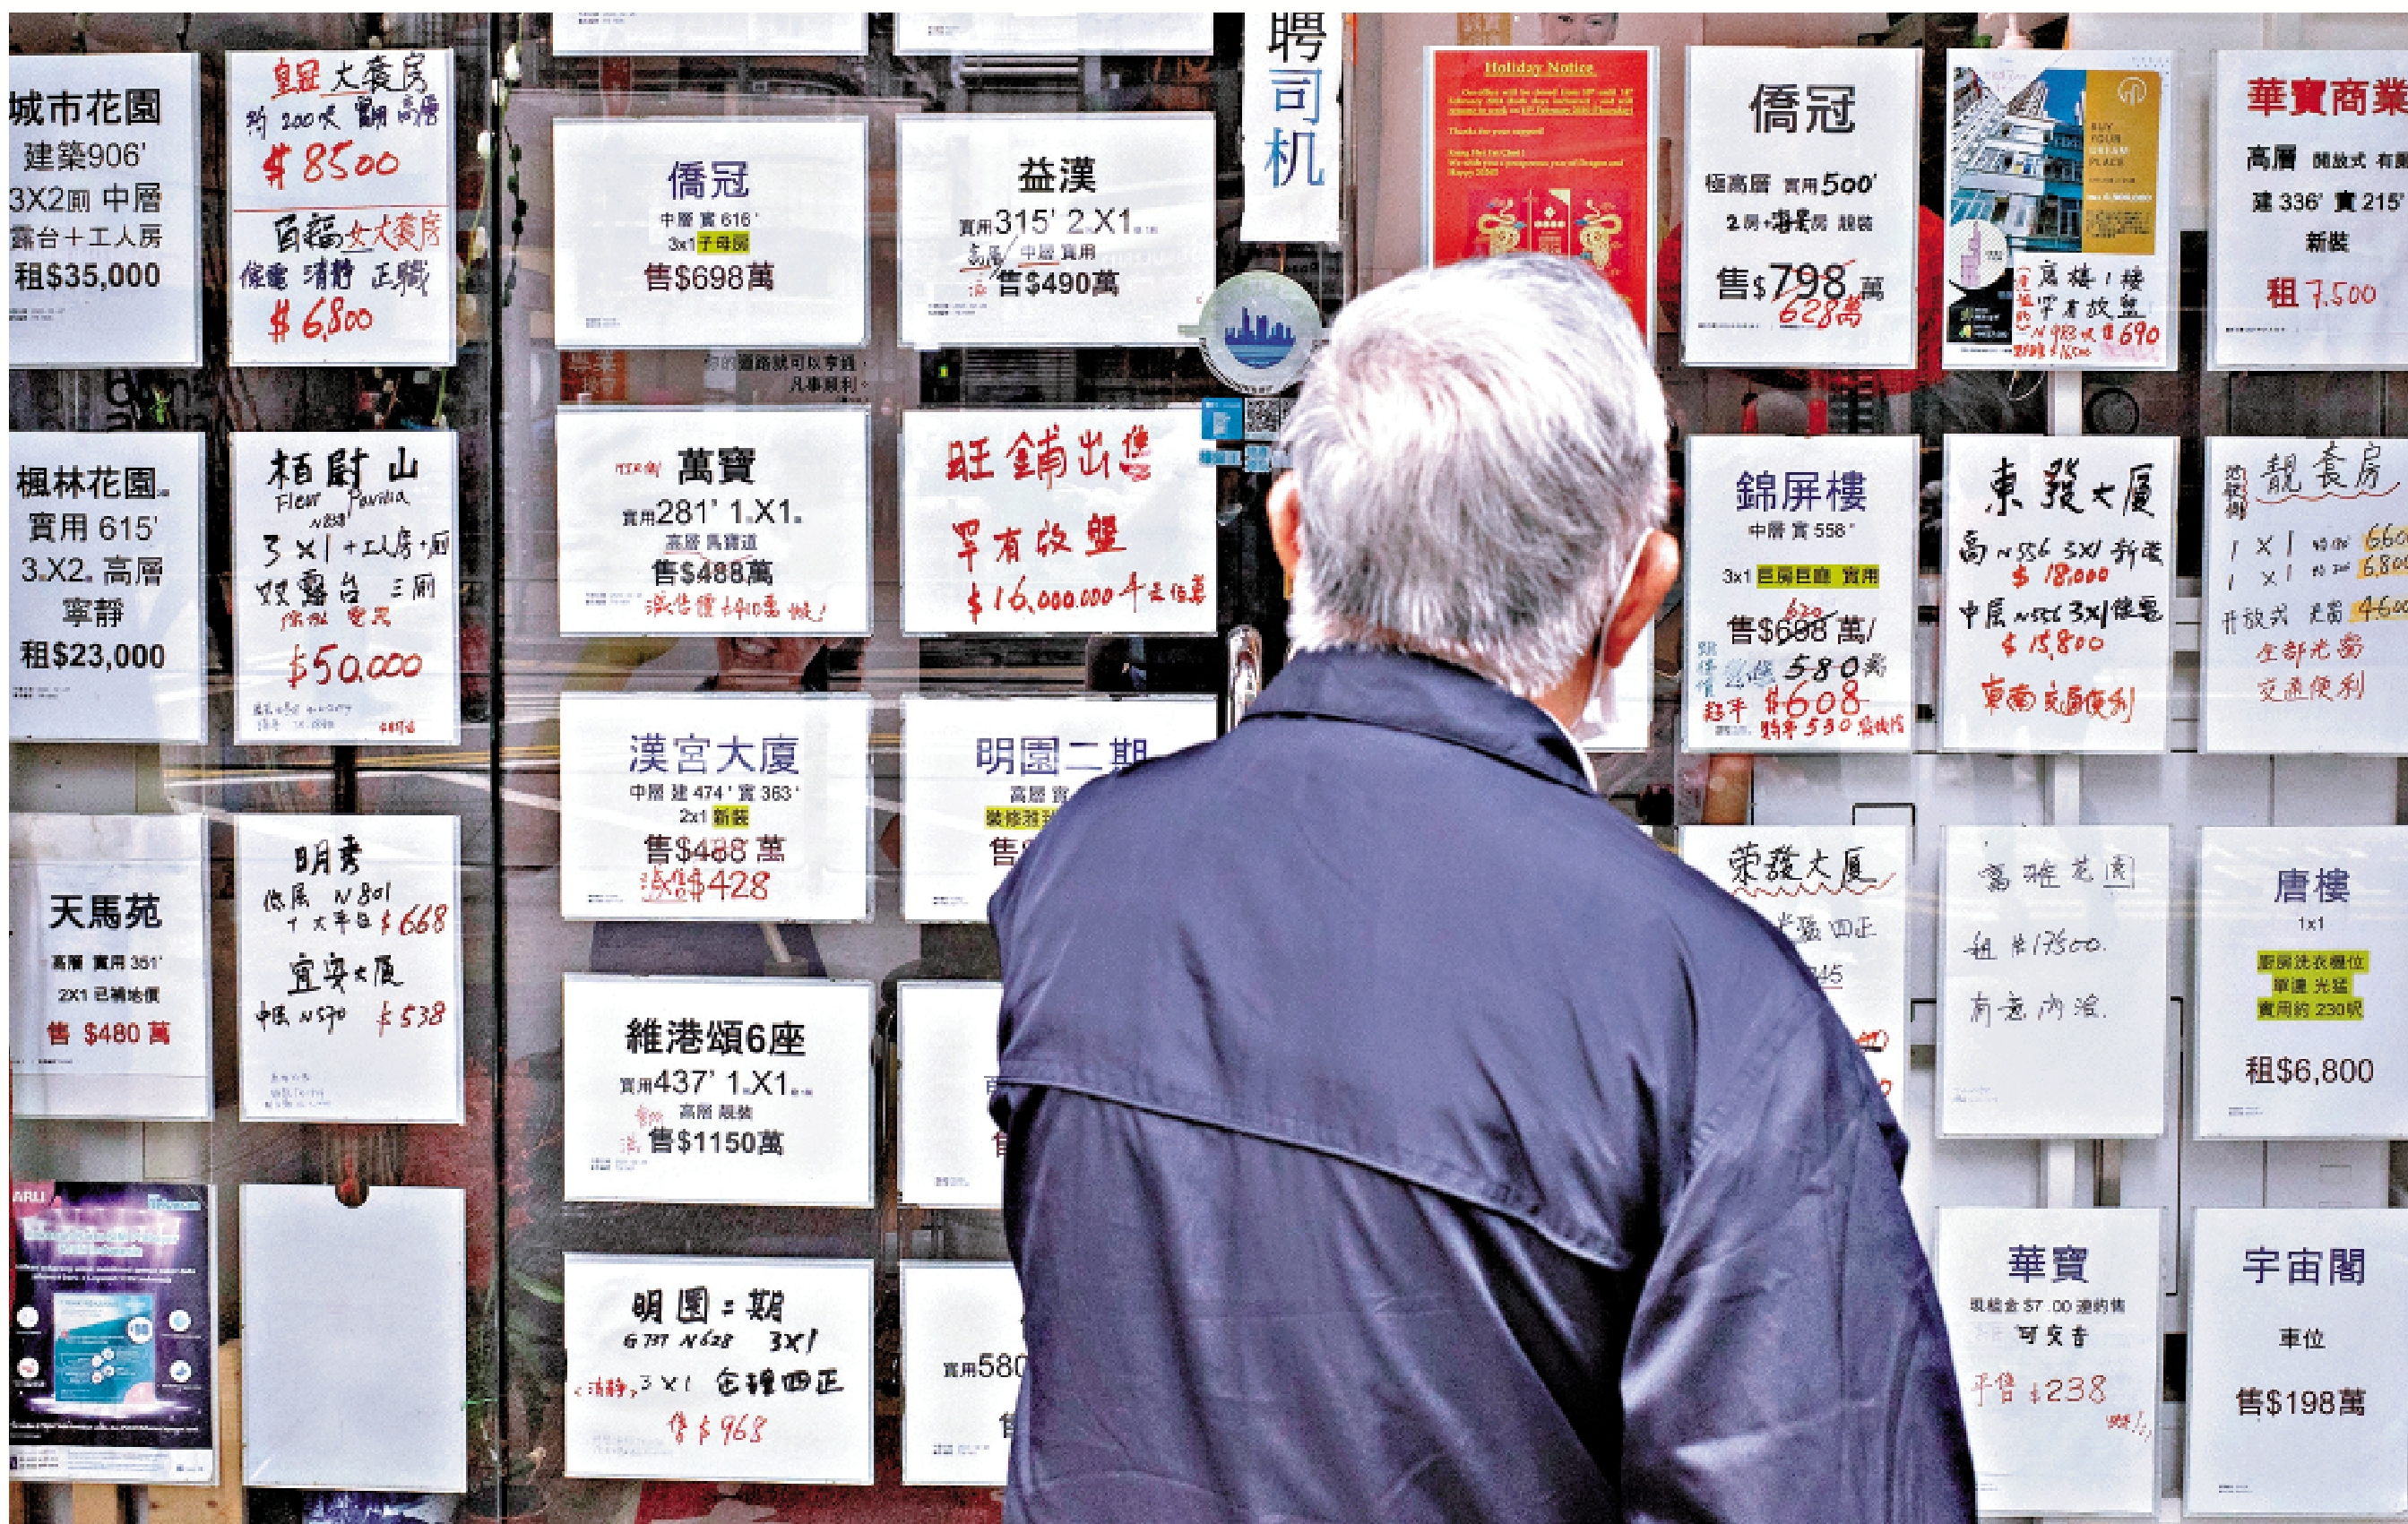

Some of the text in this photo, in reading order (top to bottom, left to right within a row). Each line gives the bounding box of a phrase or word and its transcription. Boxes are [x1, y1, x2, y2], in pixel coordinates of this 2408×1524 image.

[1485, 61, 1594, 75] Holiday Notice
[9, 88, 160, 125] 城市花園
[1748, 83, 1855, 133] 僑冠
[2247, 77, 2408, 117] 華寶商業
[2091, 122, 2113, 131] BUY
[24, 140, 146, 172] 建築906'
[2248, 144, 2297, 171] 高層
[667, 160, 750, 200] 僑冠
[1018, 157, 1096, 194] 益漢
[103, 182, 162, 214] 中層
[2252, 190, 2273, 212] 建
[2335, 190, 2356, 212] 實
[959, 207, 1056, 237] 實用315'
[2306, 230, 2350, 253] 新裝
[14, 261, 160, 291] 租$35,000
[644, 260, 774, 292] 售$698萬
[999, 268, 1120, 297] 售$490萬
[16, 464, 157, 499] 楓林花園
[267, 446, 419, 489] 柏尉山
[678, 447, 755, 486] 萬寶
[275, 490, 321, 512] Fleur
[1736, 470, 1867, 512] 錦屏樓
[30, 512, 158, 543] 實用 615'
[623, 499, 717, 526] 實用281'
[103, 555, 163, 586] 高層
[652, 559, 773, 586] 售$488萬
[1843, 566, 1878, 585] 實用
[62, 596, 125, 628] 寧靜
[20, 641, 165, 672] 租$23,000
[630, 733, 798, 774] 漢宮大廈
[2274, 868, 2350, 903] 唐樓
[48, 891, 162, 929] 天馬苑
[2298, 916, 2324, 931] 1x1
[51, 954, 83, 971] 高層
[93, 954, 125, 971] 實用
[58, 986, 160, 1004] 2X1 已補地價
[47, 1020, 170, 1046] 售 $480 萬
[625, 1017, 806, 1056] 維港頌6座
[620, 1069, 715, 1096] 實用437'
[2246, 1055, 2374, 1085] 租$6,800
[649, 1126, 785, 1157] 售$1150萬
[2007, 1244, 2089, 1283] 華寶
[2243, 1245, 2365, 1286] 宇宙閣
[2279, 1327, 2326, 1350] 車位
[2236, 1387, 2367, 1418] 售$198萬
